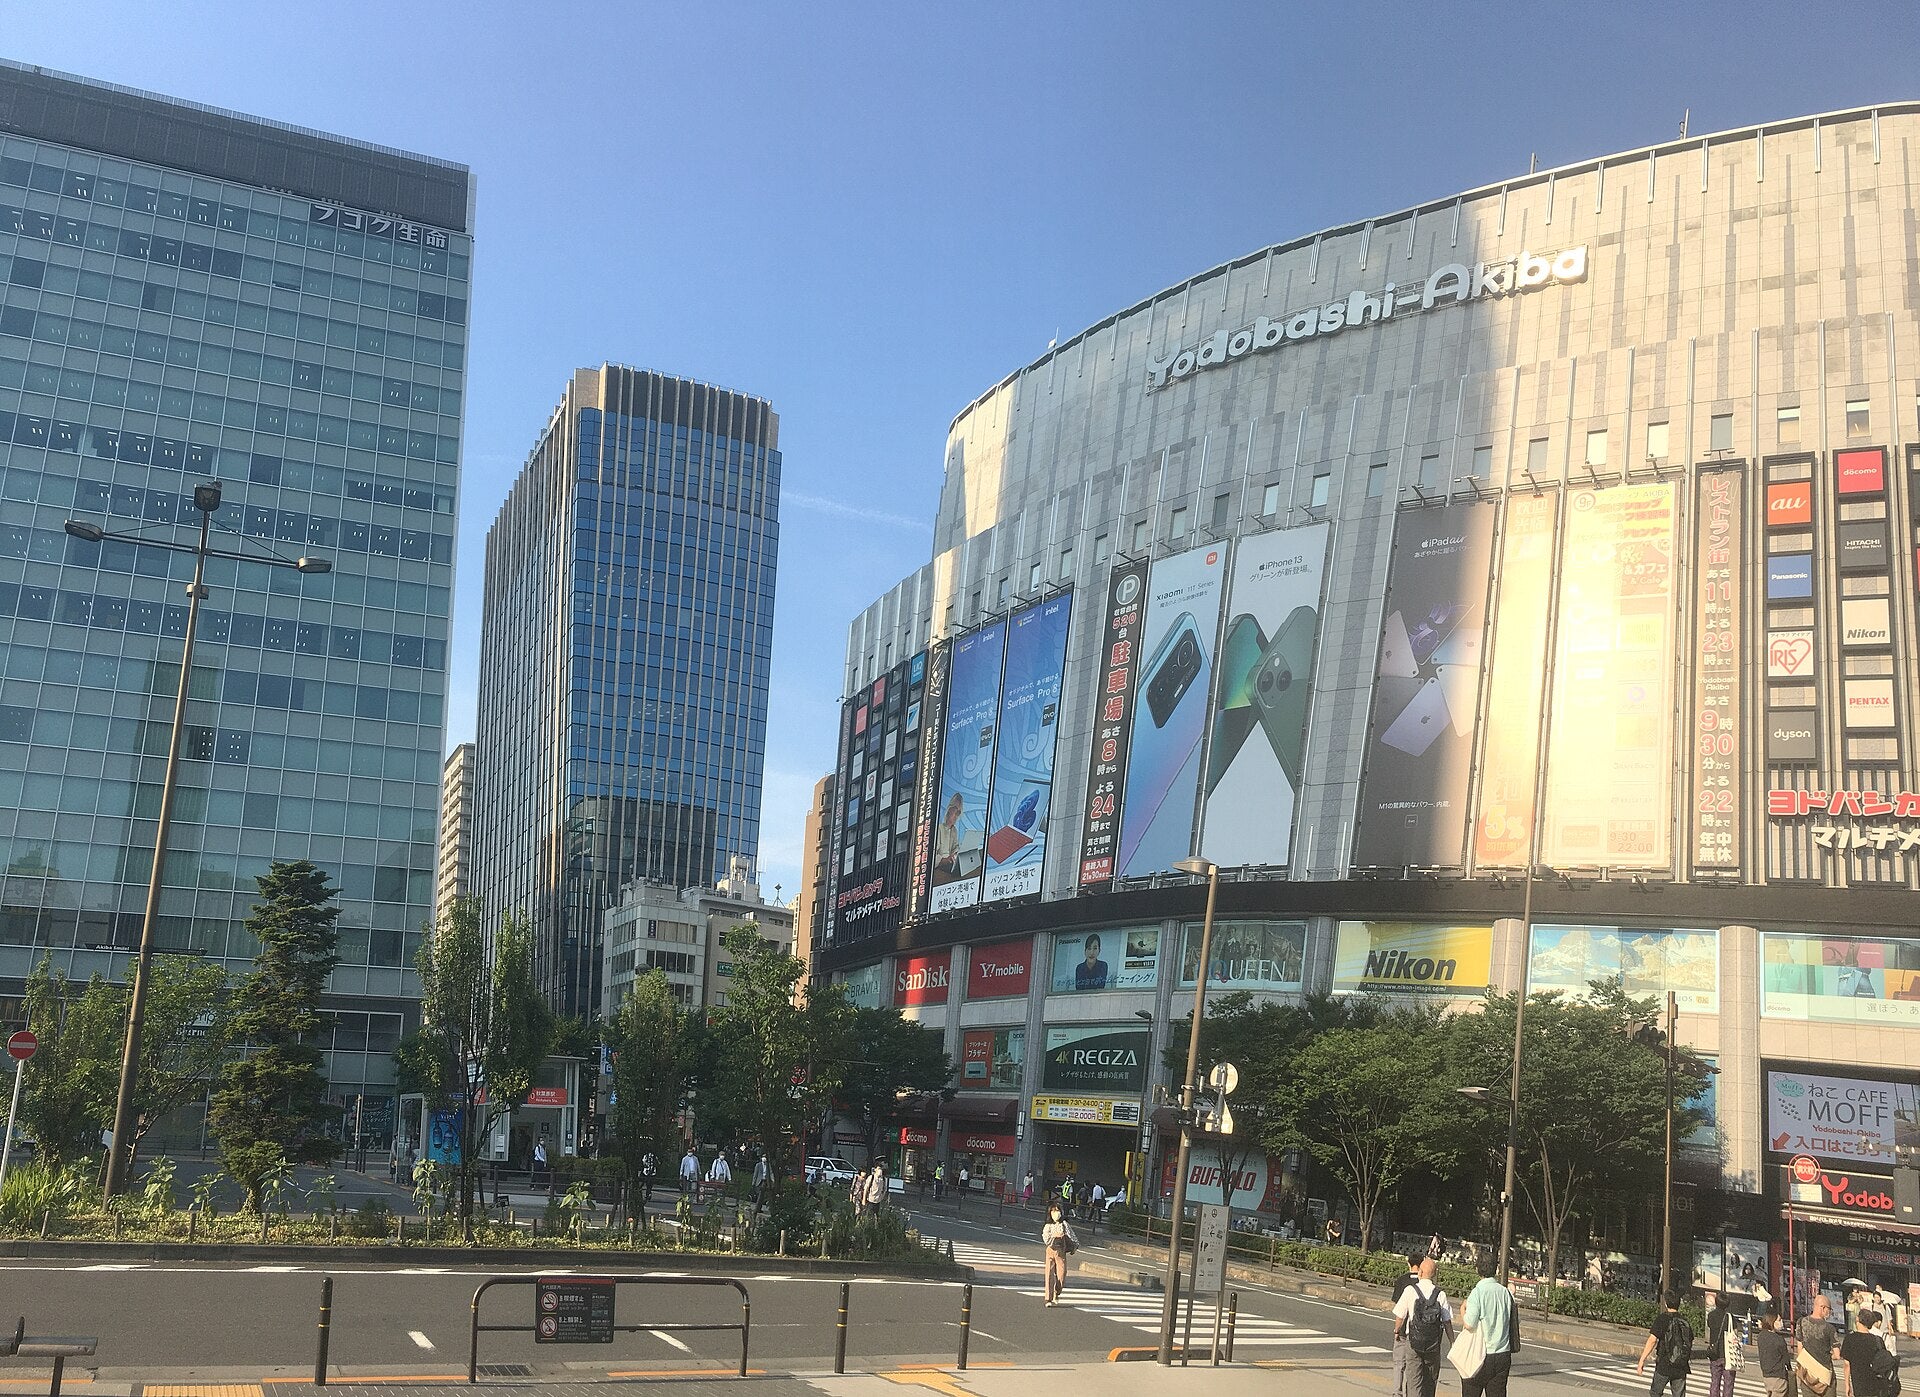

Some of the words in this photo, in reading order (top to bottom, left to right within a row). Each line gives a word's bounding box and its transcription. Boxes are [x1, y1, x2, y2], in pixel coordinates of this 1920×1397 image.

[313, 204, 447, 248] フコク生命
[1146, 245, 1588, 388] Yodobashi-Akiba
[1843, 468, 1877, 476] docomo
[1770, 496, 1807, 511] au
[1708, 478, 1730, 564] レストラン街
[1428, 536, 1449, 547] iPad
[1265, 557, 1293, 571] iPhone
[1293, 555, 1303, 565] 13
[1706, 568, 1731, 579] あさ
[1771, 572, 1808, 580] Panasonic
[1156, 588, 1183, 601] xiaomi
[1705, 580, 1731, 602] 11
[1045, 604, 1059, 616] intel
[1704, 603, 1731, 614] 時から
[1112, 611, 1137, 630] 520
[1705, 618, 1730, 629] よる
[1702, 631, 1734, 653] 23
[1846, 629, 1886, 639] Nikon
[1704, 654, 1731, 666] 時まで
[1769, 649, 1797, 667] IRIS
[1103, 640, 1131, 722] 駐車場
[1007, 692, 1034, 710] Surface
[1037, 687, 1051, 699] Pro
[1052, 683, 1059, 694] 8
[1704, 695, 1730, 706] あさ
[1849, 697, 1889, 705] PENTAX
[951, 715, 974, 731] Surface
[975, 711, 987, 722] Pro
[1043, 710, 1056, 720] evo
[1700, 709, 1733, 731] 9時
[1101, 726, 1121, 739] あさ
[1773, 728, 1811, 741] dyson
[1101, 738, 1117, 761] 8
[1699, 733, 1734, 755] 30
[1702, 757, 1731, 770] 分から
[1095, 781, 1114, 794] よる
[1702, 775, 1730, 787] よる
[1090, 793, 1115, 819] 24
[1699, 790, 1734, 813] 22
[1701, 814, 1731, 828] 時まで
[1699, 831, 1732, 847] 年中
[1699, 847, 1732, 862] 無休
[990, 867, 1036, 884] パソコン売場で
[936, 881, 976, 897] パソコン売場で
[992, 881, 1030, 897] 体験しよう!
[845, 899, 882, 923] マルチメディア
[979, 962, 1024, 978] Y!mobile
[1364, 949, 1457, 981] Nikon
[897, 965, 949, 992] SanDisk
[1055, 1050, 1070, 1064] 4K
[1073, 1049, 1138, 1066] REGZA
[1807, 1083, 1838, 1100] ねこ
[1845, 1087, 1888, 1105] CAFE
[1807, 1099, 1888, 1127] MOFF
[906, 1130, 928, 1143] docomo
[1812, 1124, 1881, 1138] Yodobashi-Akiba
[966, 1136, 996, 1149] docomo
[1849, 1232, 1911, 1247] ヨドバシカメラ
